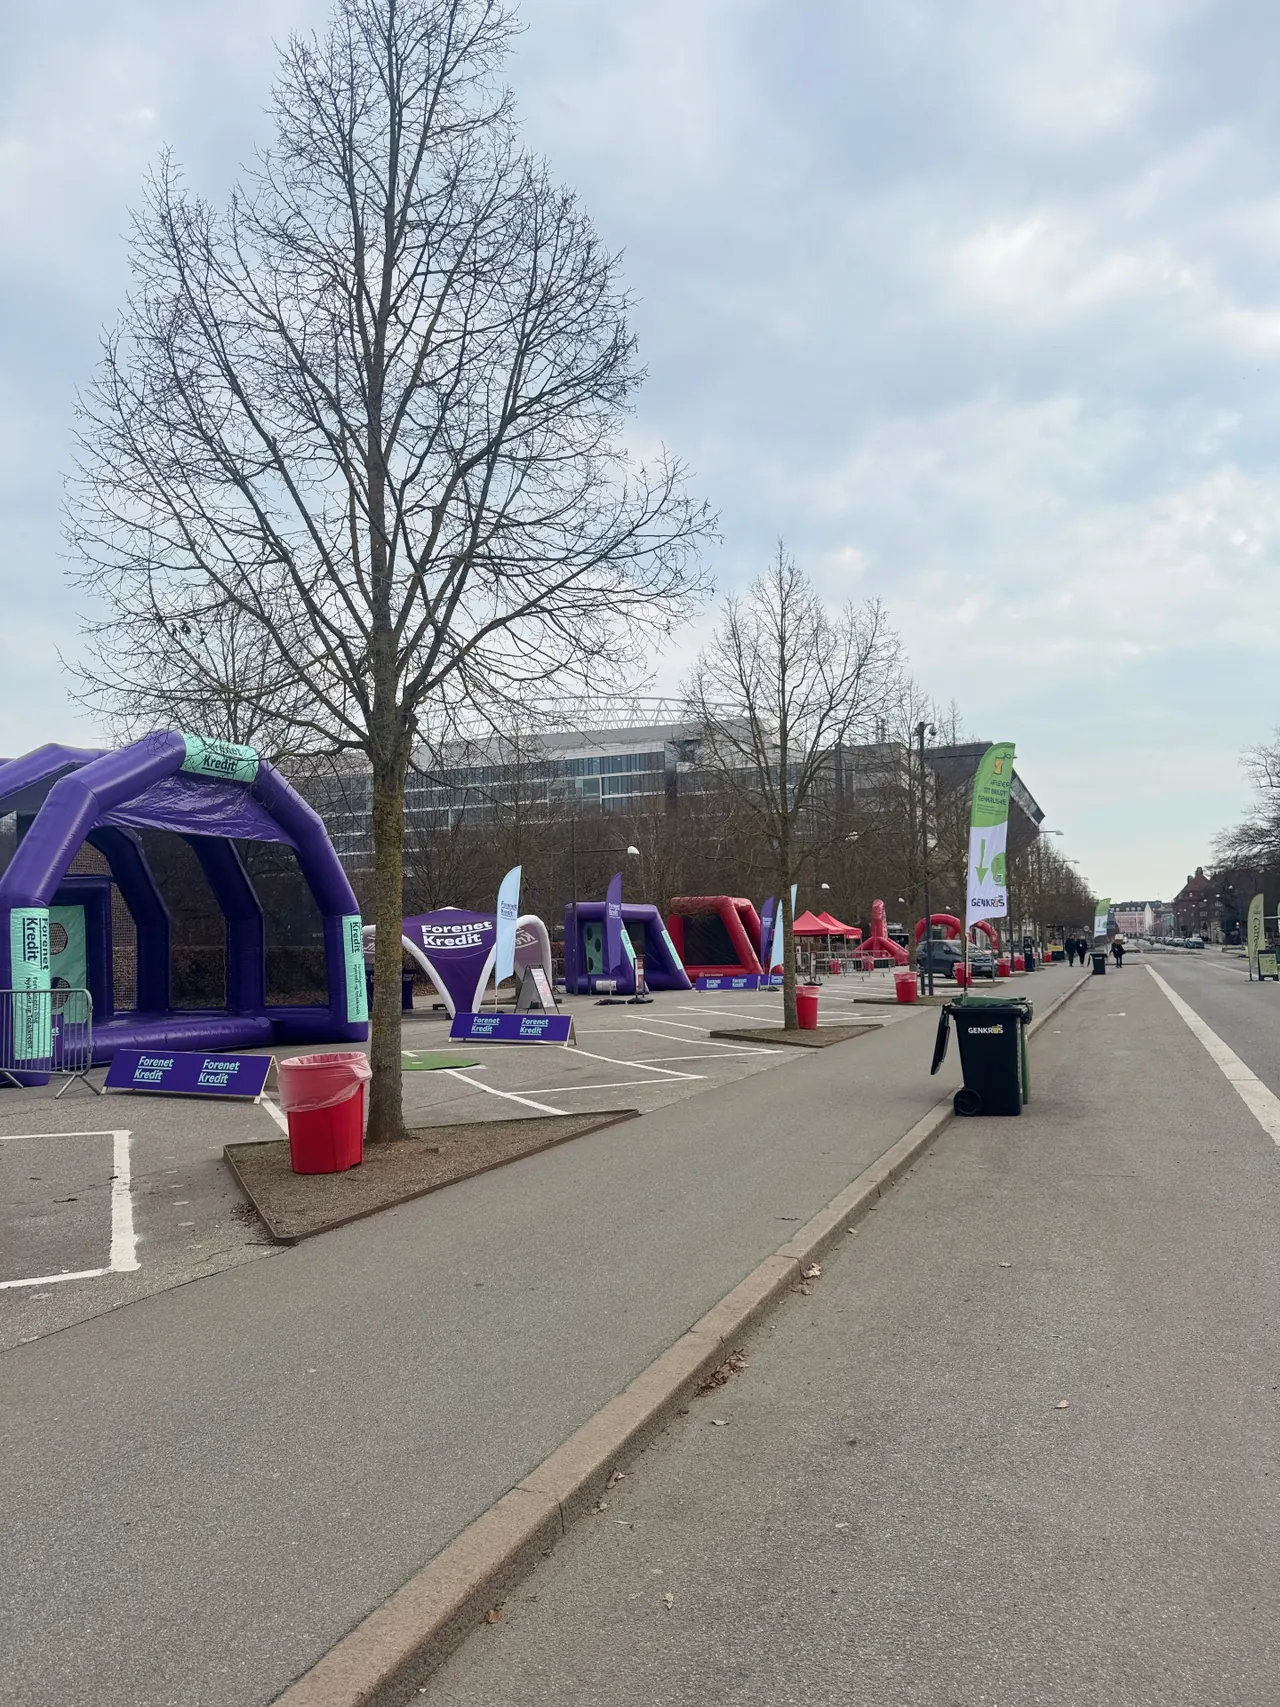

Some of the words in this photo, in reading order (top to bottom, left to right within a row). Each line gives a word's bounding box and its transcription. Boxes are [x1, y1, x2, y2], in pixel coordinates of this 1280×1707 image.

[203, 754, 237, 772] Kredit
[421, 920, 493, 934] Forenet
[26, 917, 39, 961] Kredit
[352, 921, 361, 953] Kredit
[423, 933, 482, 946] Kredit
[473, 1016, 500, 1024] Forenet
[521, 1017, 549, 1026] Forenet
[471, 1024, 493, 1032] Kredit
[520, 1026, 542, 1034] Kredit
[138, 1055, 174, 1068] Forenet
[203, 1058, 240, 1071] Forenet
[134, 1068, 163, 1080] Kredit
[199, 1072, 229, 1084] Kredit
